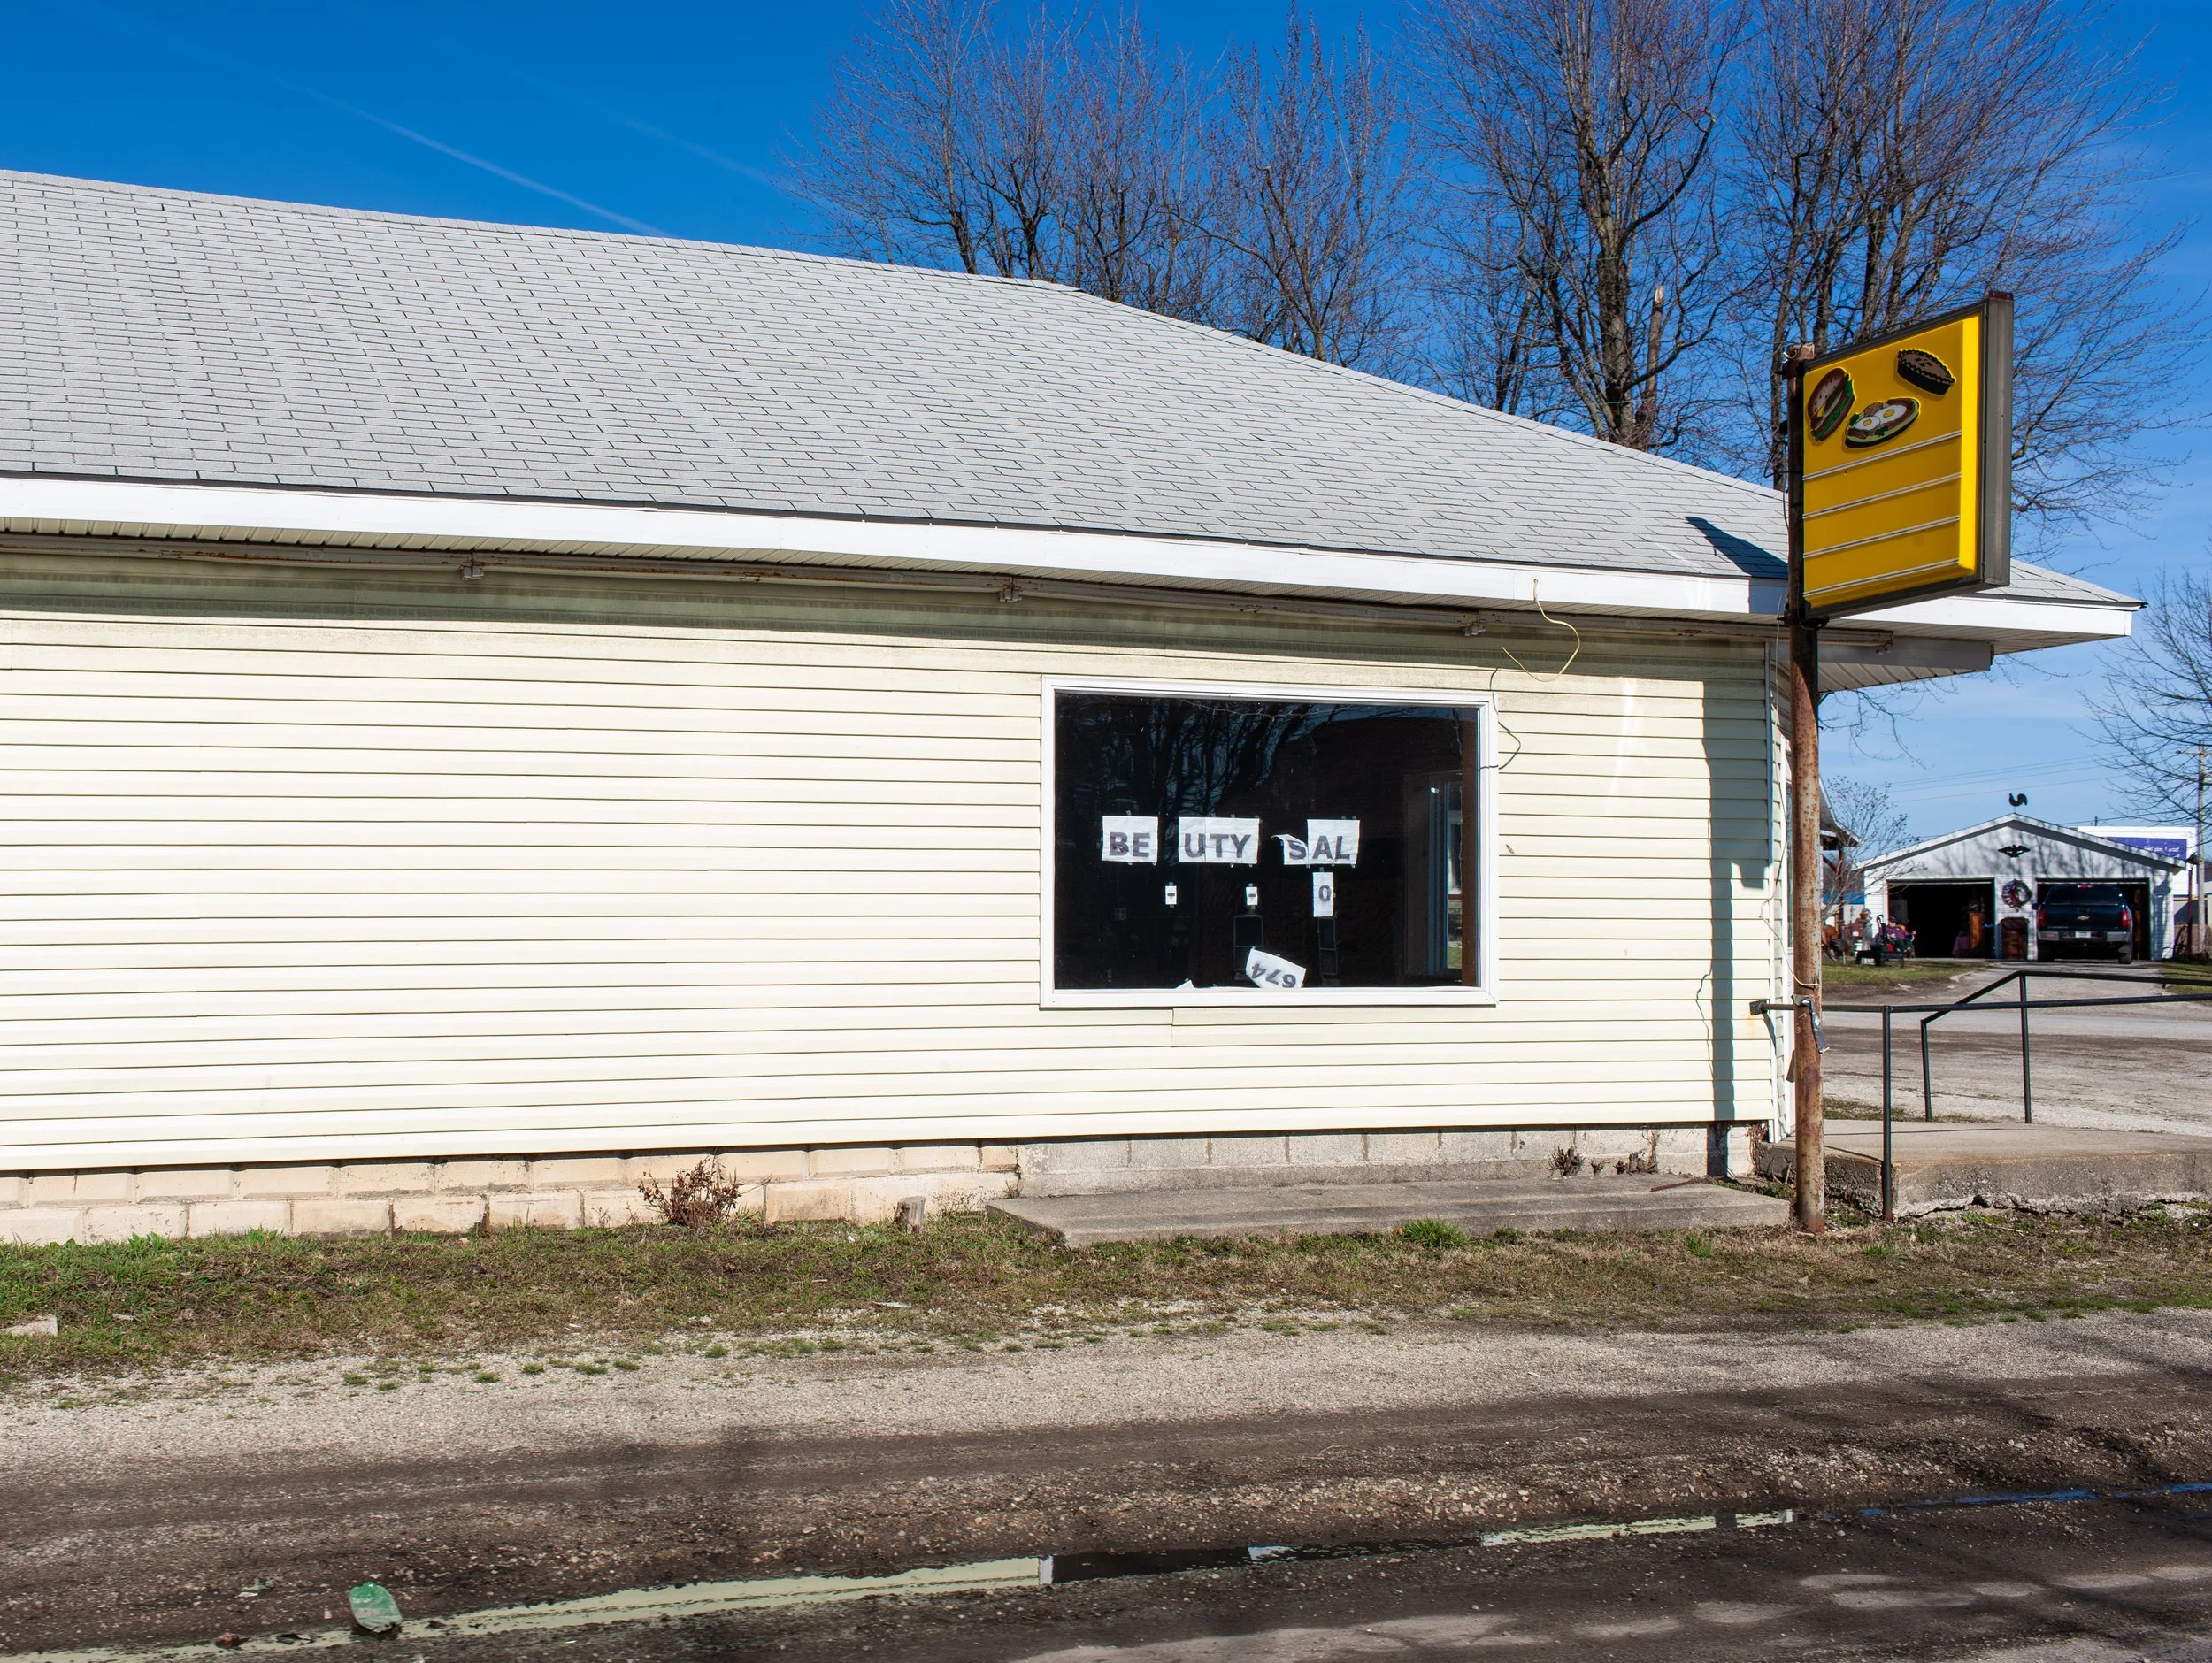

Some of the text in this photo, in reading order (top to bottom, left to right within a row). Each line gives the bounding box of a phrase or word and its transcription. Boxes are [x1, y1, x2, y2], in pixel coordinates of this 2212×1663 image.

[1184, 832, 1251, 859] UTY
[1288, 835, 1351, 861] SAL
[1251, 962, 1296, 988] 674
